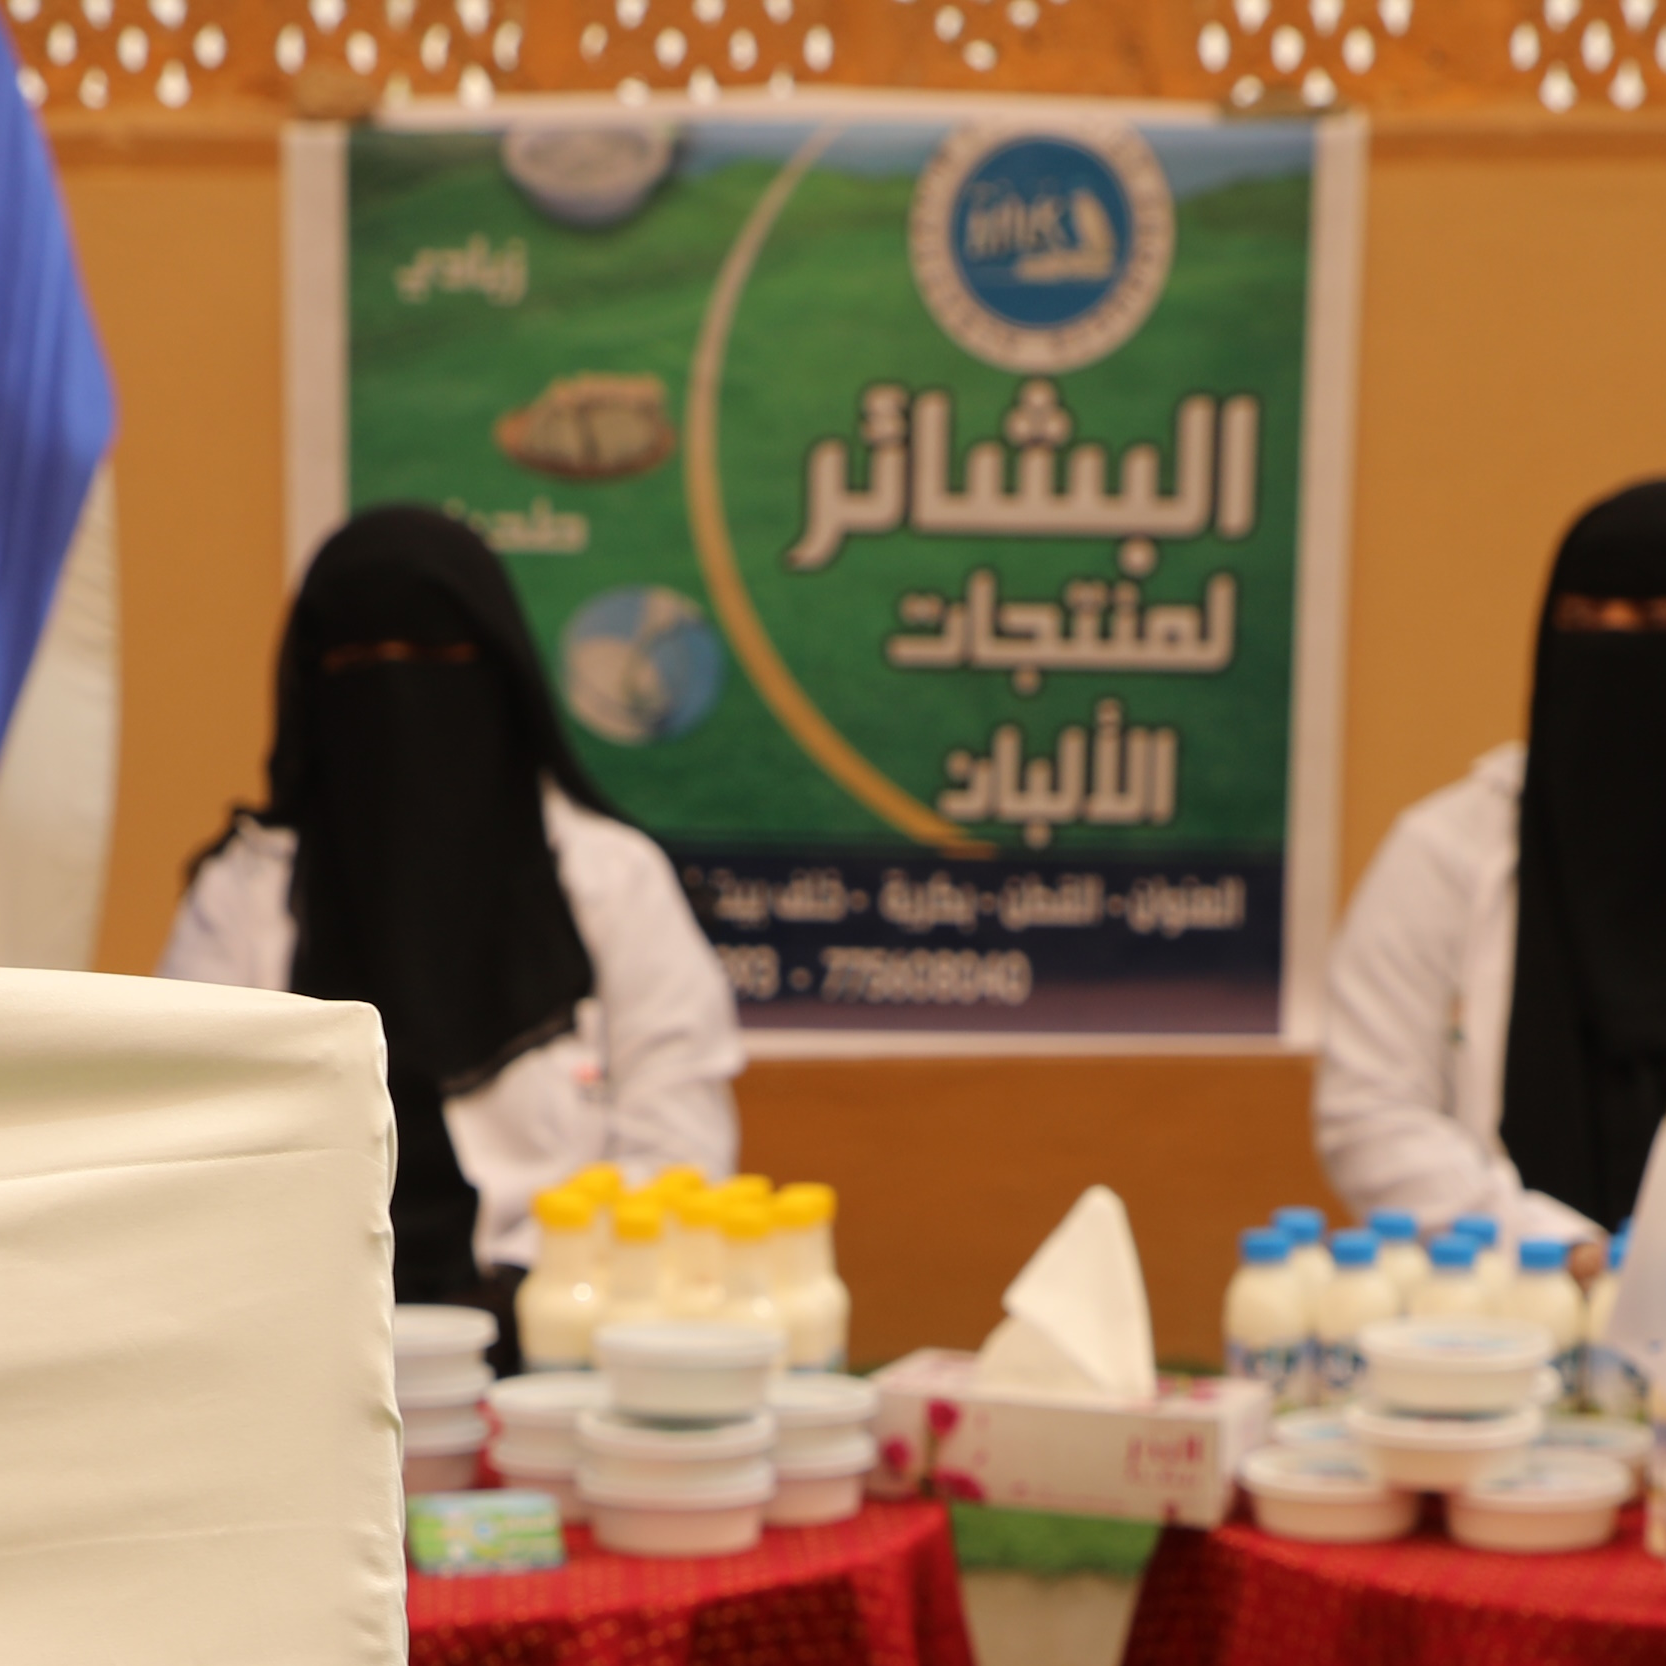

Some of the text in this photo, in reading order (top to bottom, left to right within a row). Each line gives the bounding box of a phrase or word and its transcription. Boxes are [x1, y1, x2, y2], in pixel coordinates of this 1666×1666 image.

[784, 380, 1261, 577] البشائر
[887, 567, 1237, 694] لمنتجات
[938, 699, 1179, 849] الألبان
